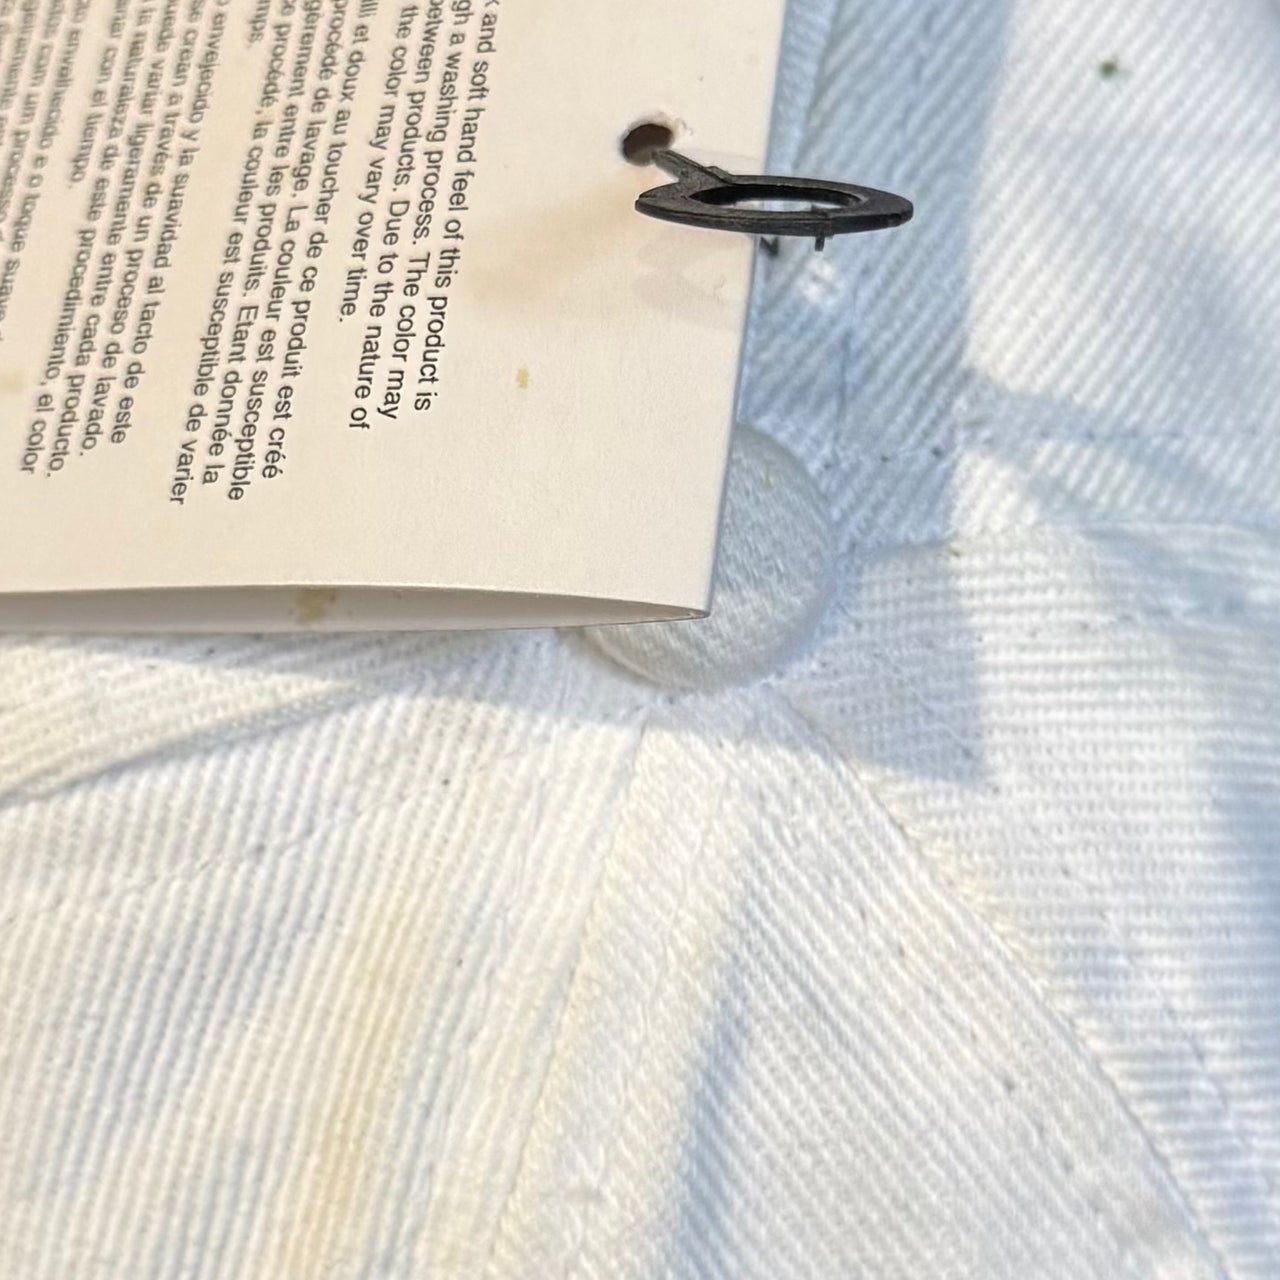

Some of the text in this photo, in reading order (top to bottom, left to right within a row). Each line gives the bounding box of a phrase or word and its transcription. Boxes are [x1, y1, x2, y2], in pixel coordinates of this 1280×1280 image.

[394, 3, 420, 39] the
[447, 30, 466, 47] a
[474, 12, 498, 54] and
[254, 21, 292, 115] procédé,
[338, 48, 366, 103] doux
[383, 43, 408, 97] color
[466, 59, 490, 101] soft
[308, 85, 332, 114] de
[330, 107, 352, 136] au
[424, 50, 462, 143] washing
[147, 109, 181, 178] través
[177, 127, 200, 142] y
[250, 118, 274, 141] la
[272, 102, 299, 158] entre
[367, 103, 396, 150] may
[392, 89, 426, 191] products.
[455, 106, 485, 163] hand
[97, 142, 121, 172] de
[176, 146, 200, 167] la
[263, 163, 290, 197] les
[290, 118, 326, 198] lavage.
[356, 156, 385, 205] vary
[84, 175, 110, 222] este
[104, 121, 153, 246] ligeramente
[140, 179, 163, 209] de
[232, 144, 263, 224] couleur
[313, 140, 347, 224] toucher
[411, 148, 444, 245] process.
[447, 168, 475, 212] feel
[131, 213, 153, 243] un
[151, 172, 189, 269] suavidad
[282, 203, 309, 234] La
[350, 209, 374, 261] over
[381, 198, 411, 246] Due
[441, 217, 465, 240] of
[221, 229, 244, 265] est
[241, 201, 277, 297] produits.
[304, 229, 329, 259] de
[375, 251, 399, 275] to
[433, 246, 461, 289] this
[88, 250, 117, 308] entre
[107, 247, 144, 335] proceso
[145, 274, 166, 295] al
[264, 237, 296, 321] couleur
[297, 264, 319, 293] ce
[338, 266, 368, 322] time.
[401, 250, 431, 297] The
[39, 227, 96, 386] procedimiento,
[367, 280, 394, 318] the
[72, 311, 101, 367] cada
[130, 299, 161, 355] tacto
[192, 270, 234, 396] susceptible
[226, 303, 259, 364] Etant
[254, 327, 277, 363] est
[280, 298, 311, 378] produit
[391, 303, 417, 362] color
[417, 294, 448, 384] product
[99, 339, 124, 369] de
[121, 359, 146, 389] de
[353, 324, 382, 399] nature
[33, 391, 55, 413] el
[79, 374, 117, 456] lavado.
[183, 401, 208, 432] de
[206, 368, 242, 456] donnée
[271, 383, 294, 421] est
[347, 405, 371, 429] of
[375, 368, 405, 419] may
[412, 390, 438, 411] is
[46, 372, 86, 477] producto.
[108, 394, 134, 444] este
[226, 369, 268, 500] susceptible
[19, 417, 47, 474] color
[260, 426, 286, 479] créé
[168, 438, 197, 505] varier
[200, 462, 226, 485] la
